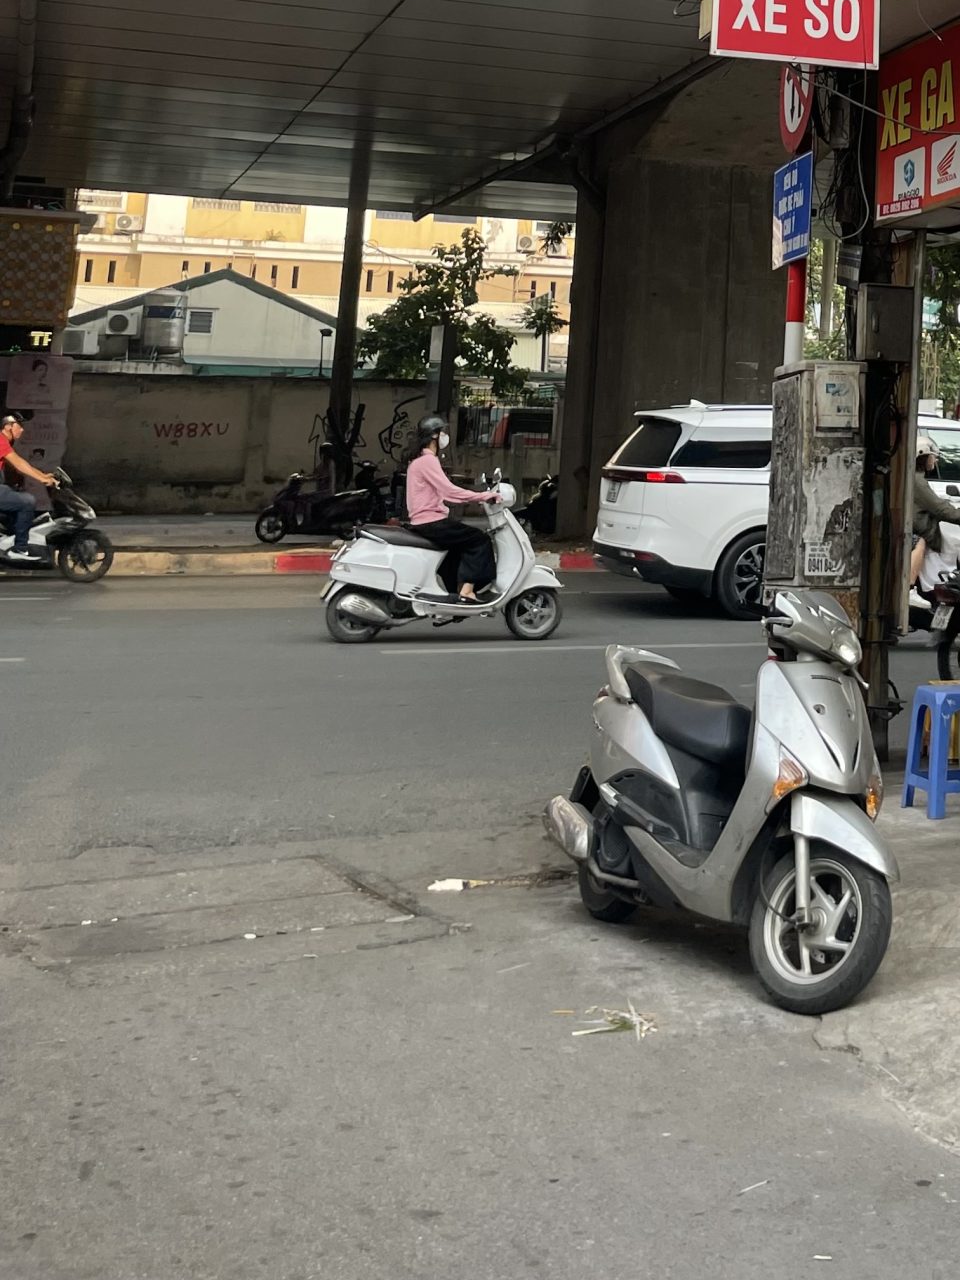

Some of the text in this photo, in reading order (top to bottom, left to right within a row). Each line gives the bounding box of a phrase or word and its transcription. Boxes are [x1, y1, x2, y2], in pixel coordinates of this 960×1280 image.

[880, 79, 912, 151] XE
[920, 60, 955, 135] GA
[937, 173, 957, 185] HONDA
[897, 188, 920, 200] PIAGGIO
